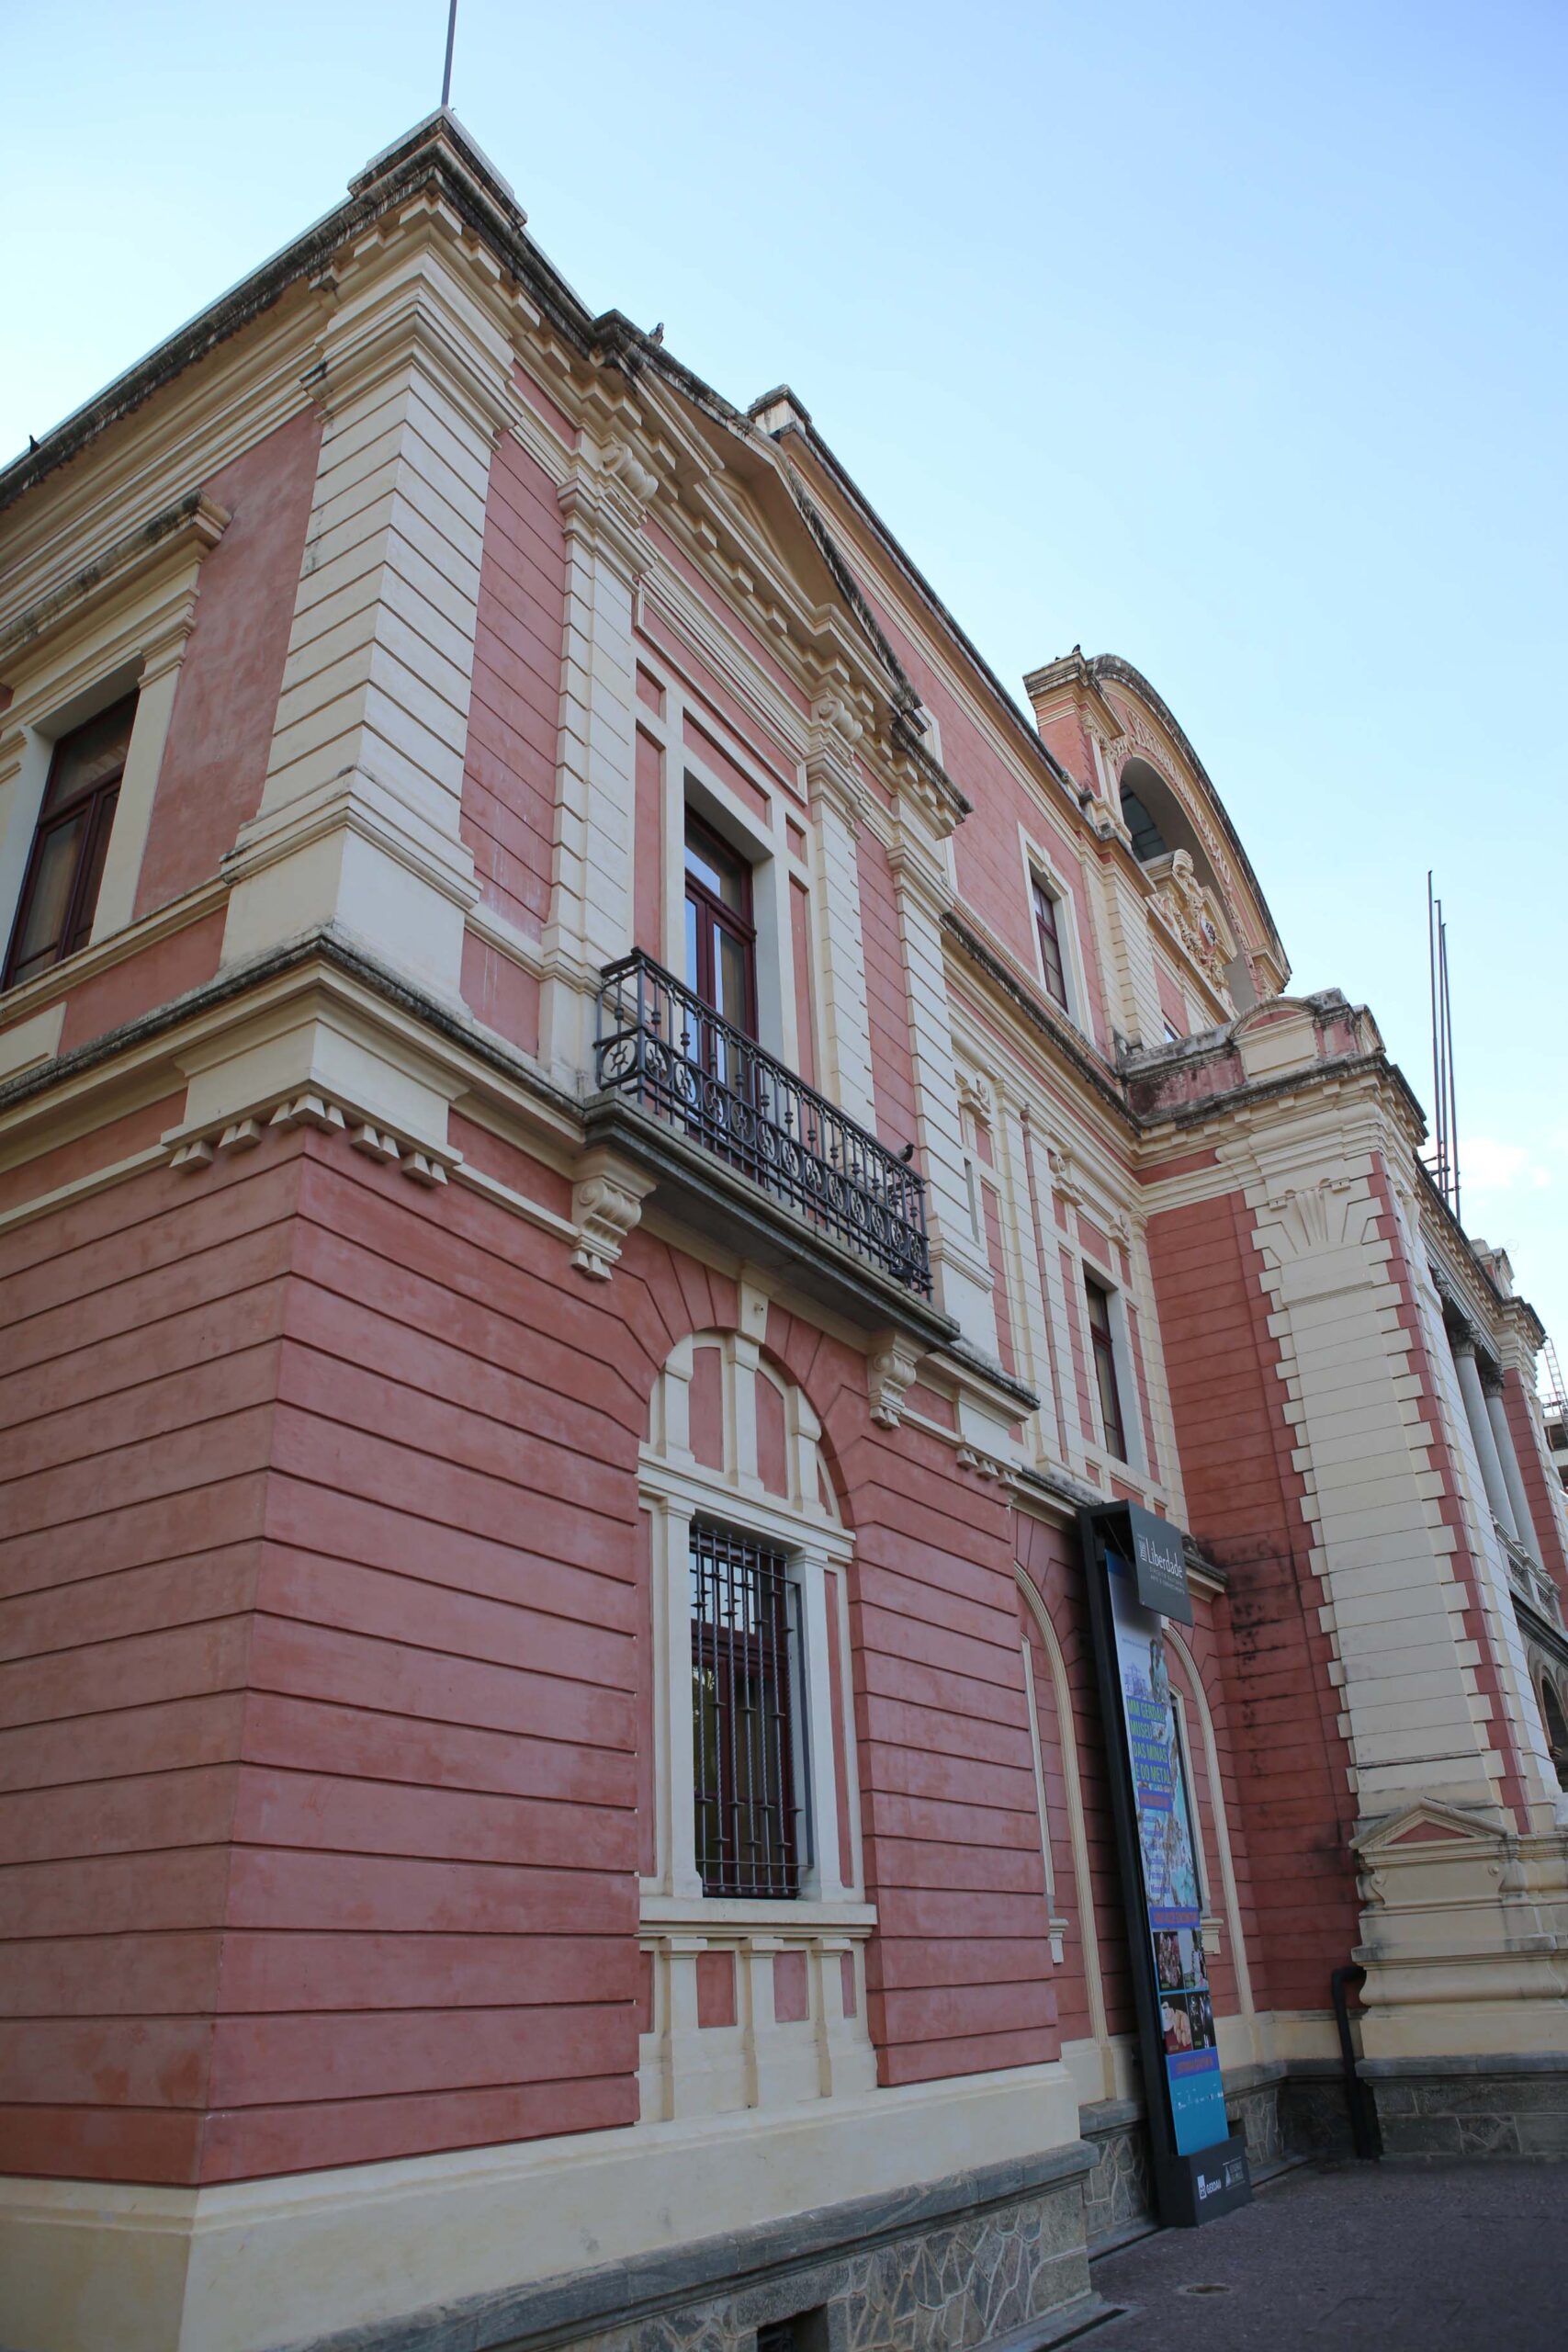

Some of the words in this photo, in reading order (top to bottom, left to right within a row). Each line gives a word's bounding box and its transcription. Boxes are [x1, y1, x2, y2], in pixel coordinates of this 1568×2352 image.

[1145, 1537, 1183, 1578] Liberdade
[1131, 1721, 1153, 1739] MUSEU
[1133, 1742, 1146, 1758] DAS
[1147, 1746, 1168, 1762] MINAS
[1134, 1762, 1139, 1780] E
[1141, 1764, 1150, 1781] DO
[1150, 1766, 1171, 1784] METAL
[1206, 2179, 1221, 2194] GERDAU
